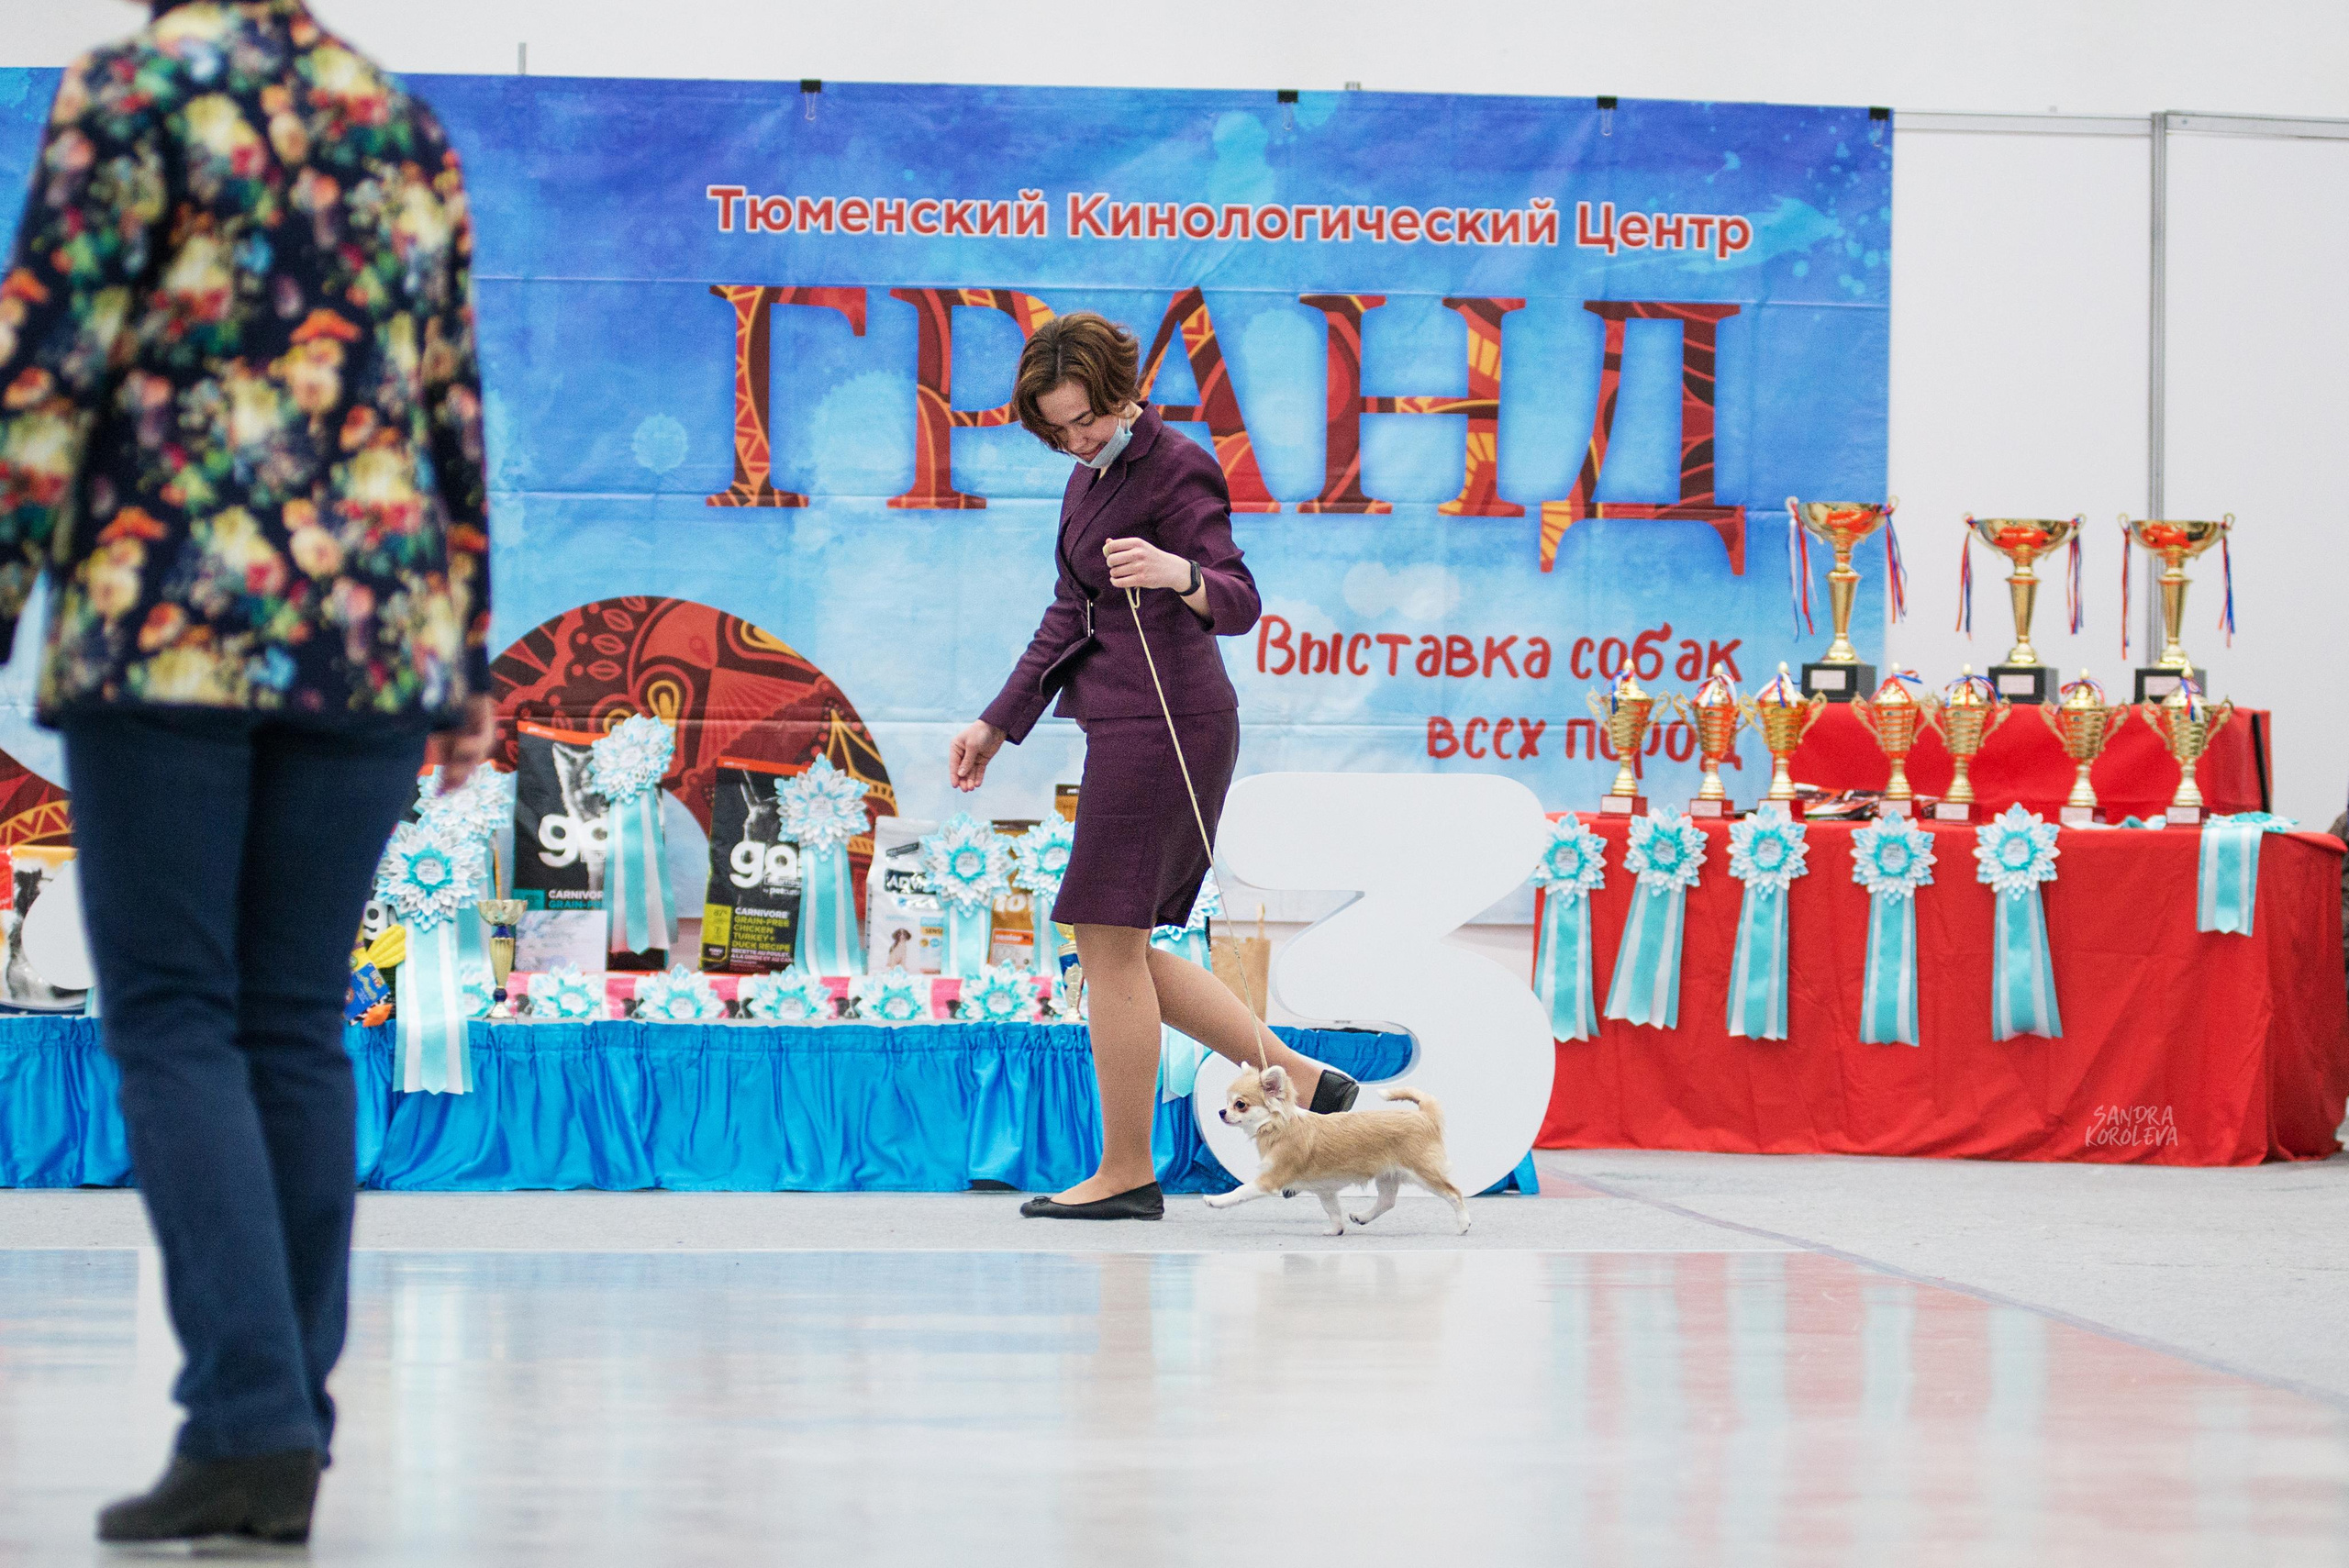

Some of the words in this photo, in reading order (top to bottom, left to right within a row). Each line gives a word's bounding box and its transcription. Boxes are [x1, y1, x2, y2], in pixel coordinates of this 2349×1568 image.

[707, 185, 1048, 238] Тюменский
[1066, 191, 1559, 246] Кинологический
[1575, 199, 1753, 260] Центр
[706, 285, 1747, 575] ГРАНД
[1256, 614, 1552, 680] Выставка
[1570, 622, 1742, 683] собак
[1427, 715, 1547, 761] всех
[729, 840, 801, 888] go
[548, 889, 604, 899] CARNIVOR
[734, 906, 789, 918] CARNIVORE
[733, 916, 790, 927] GRAIN-FREE
[732, 924, 774, 934] CHICKEN
[732, 932, 768, 941] TURKEY
[731, 940, 756, 950] DUCK
[758, 942, 791, 951] RECIPE
